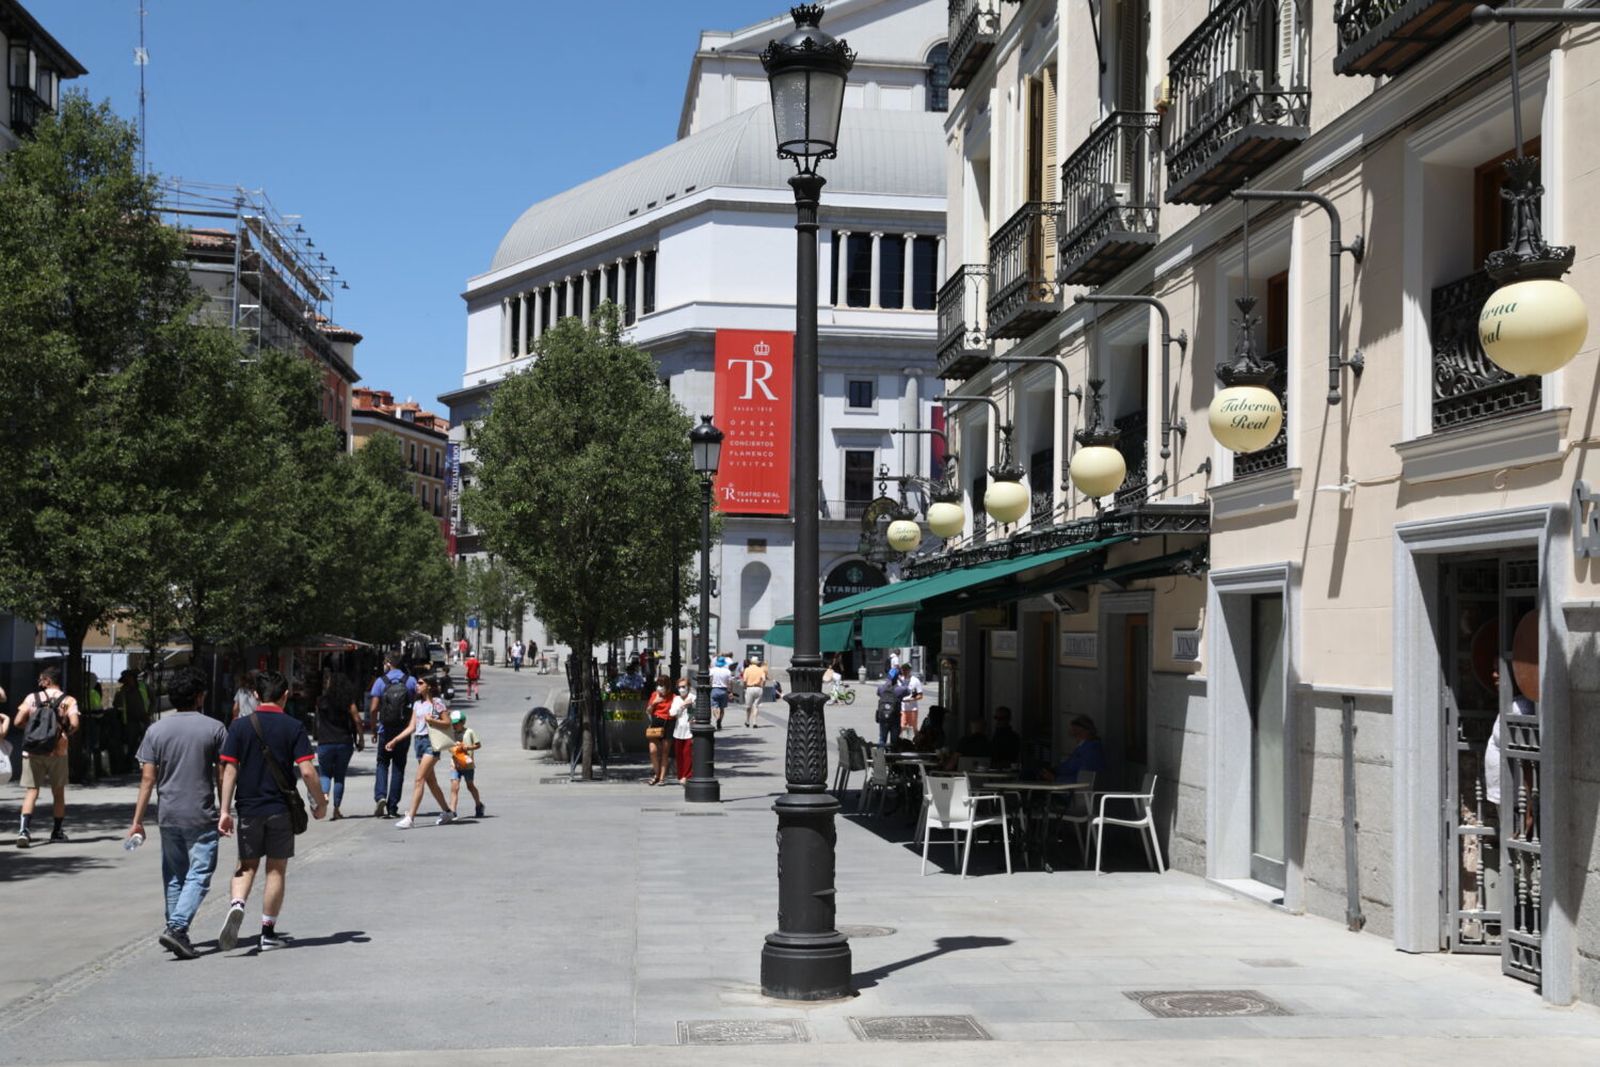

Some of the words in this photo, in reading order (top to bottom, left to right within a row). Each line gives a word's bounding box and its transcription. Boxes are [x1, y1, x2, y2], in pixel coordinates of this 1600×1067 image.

[1481, 301, 1518, 321] erna
[1480, 321, 1502, 345] eal
[727, 359, 780, 401] TR
[1220, 398, 1277, 413] Taberna
[1230, 414, 1270, 430] Real
[729, 440, 774, 448] CONCIERTOS
[729, 450, 775, 458] FLAMENCO
[825, 585, 874, 593] STARBUC
